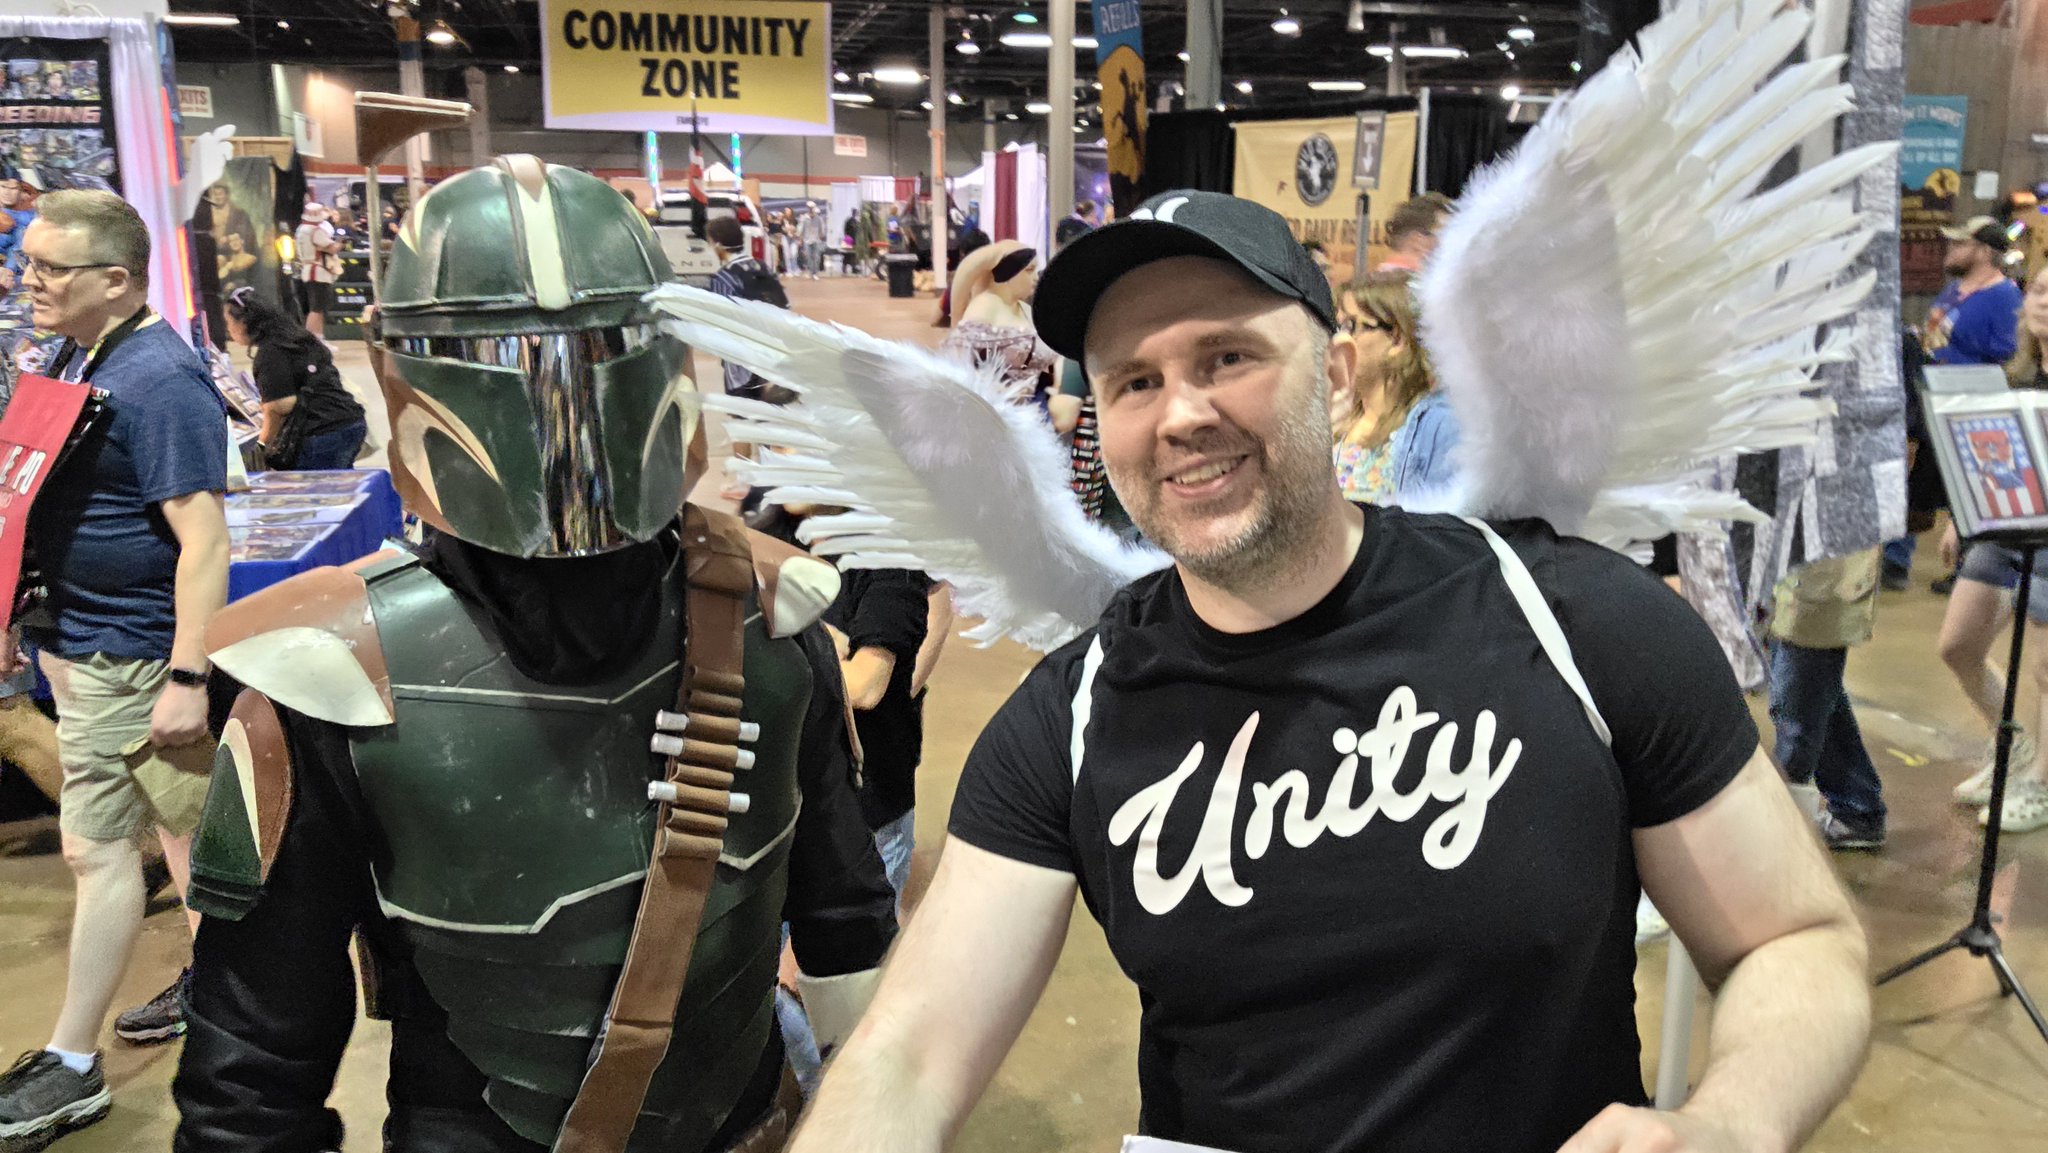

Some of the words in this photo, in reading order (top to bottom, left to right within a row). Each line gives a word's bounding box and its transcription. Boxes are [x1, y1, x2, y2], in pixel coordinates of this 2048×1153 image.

[563, 9, 811, 57] COMMUNITY
[640, 58, 740, 99] ZONE
[1108, 685, 1522, 915] Unity
